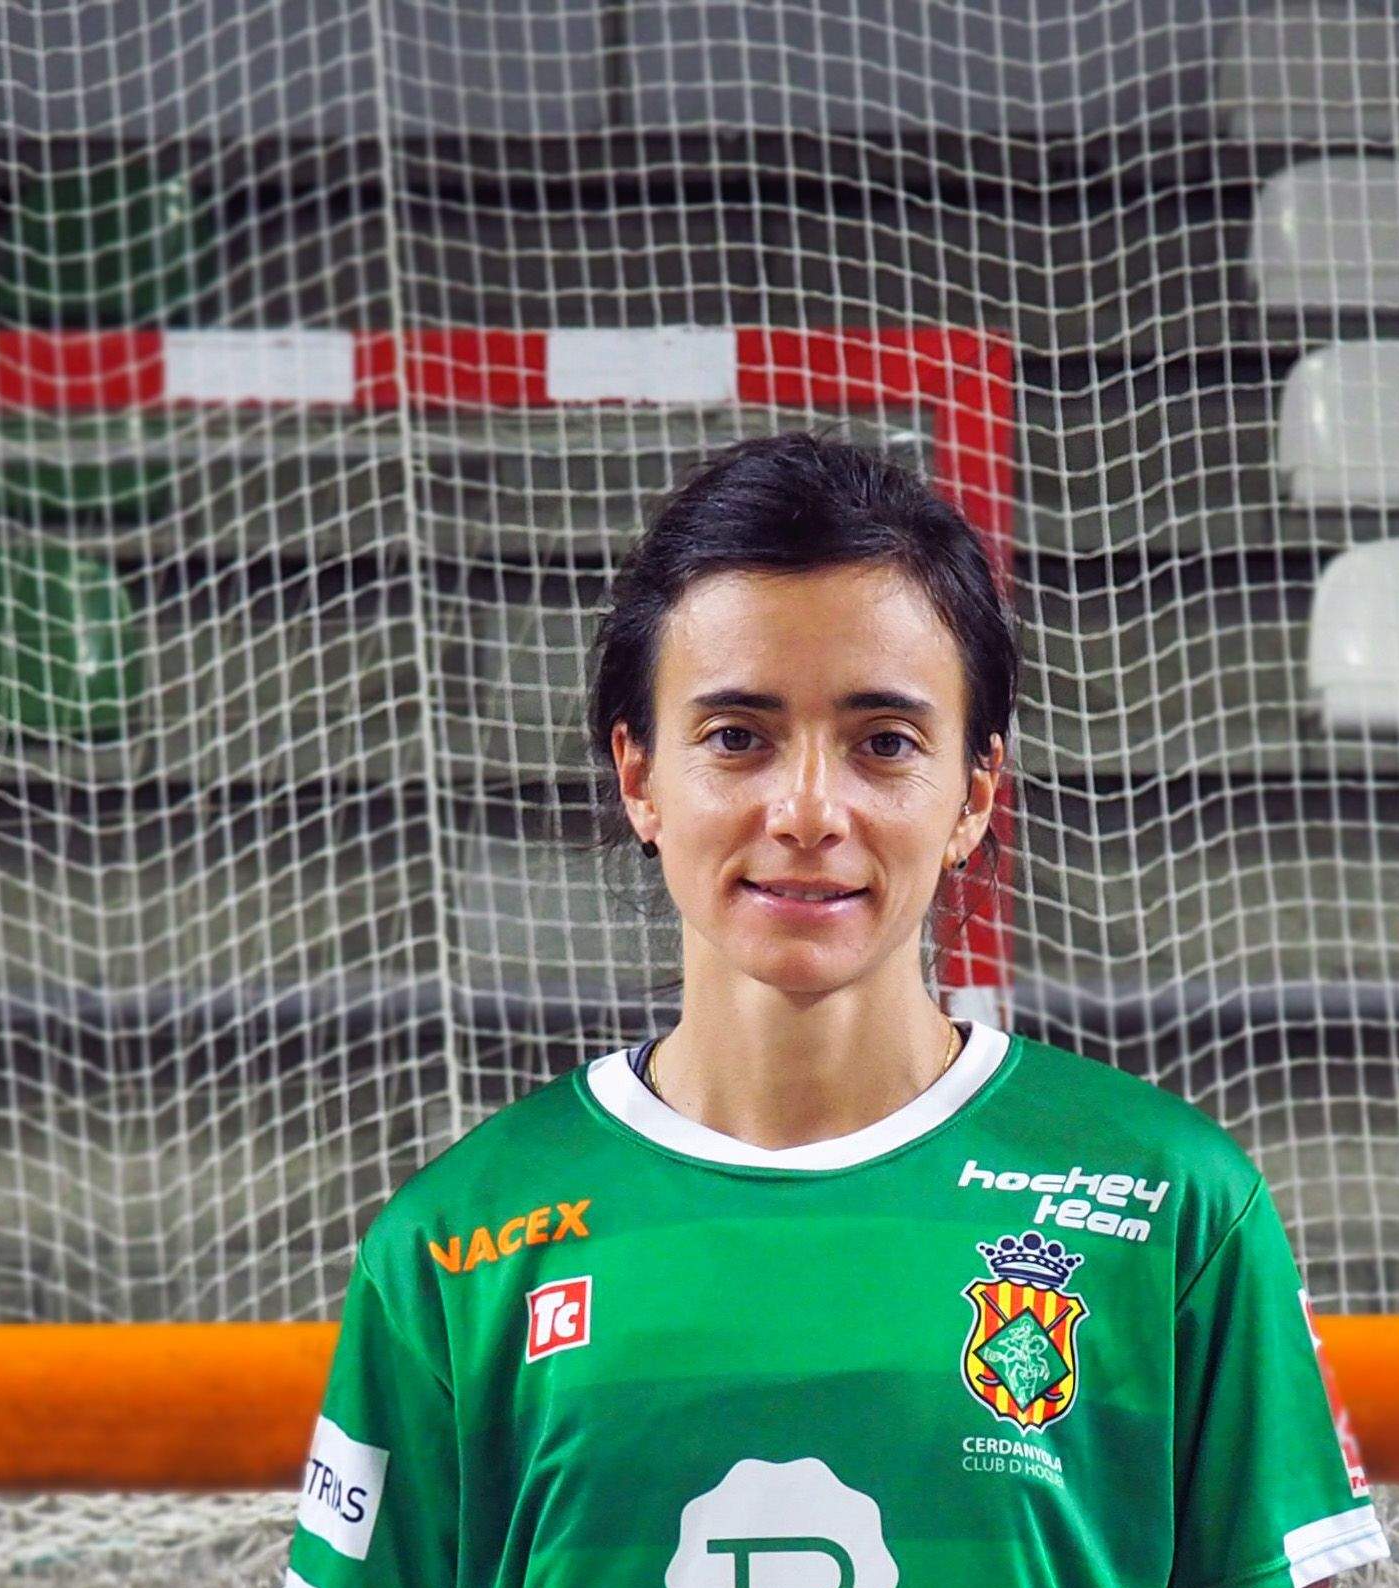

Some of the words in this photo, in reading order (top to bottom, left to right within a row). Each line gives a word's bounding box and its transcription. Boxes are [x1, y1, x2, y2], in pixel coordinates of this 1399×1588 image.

[957, 1159, 1170, 1213] hockey
[1032, 1194, 1151, 1242] team
[962, 1437, 1063, 1474] CERDANYOLA
[962, 1456, 1006, 1473] CLUB
